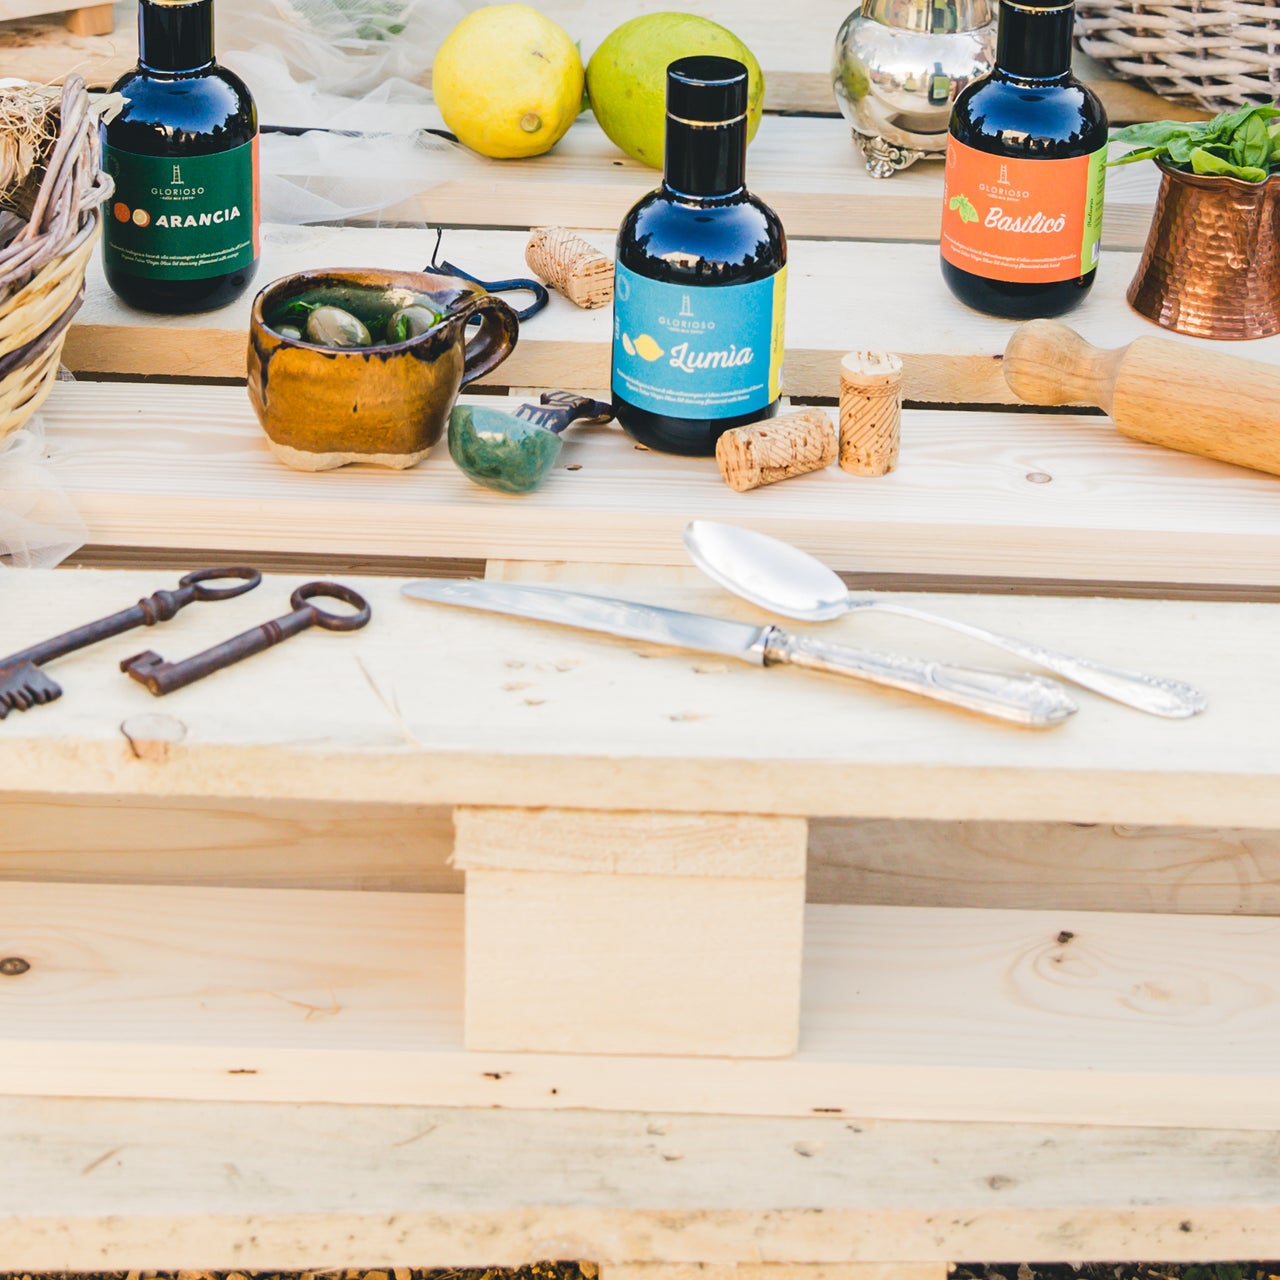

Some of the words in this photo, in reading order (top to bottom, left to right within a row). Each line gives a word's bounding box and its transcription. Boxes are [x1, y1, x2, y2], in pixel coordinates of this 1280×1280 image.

[151, 187, 205, 196] GLORIOSO
[978, 183, 1030, 199] GLORIOSO
[155, 206, 241, 228] ARANCIA
[984, 207, 1067, 234] Basilicò
[658, 316, 716, 330] GLORIOSO
[670, 342, 754, 373] Lumìa
